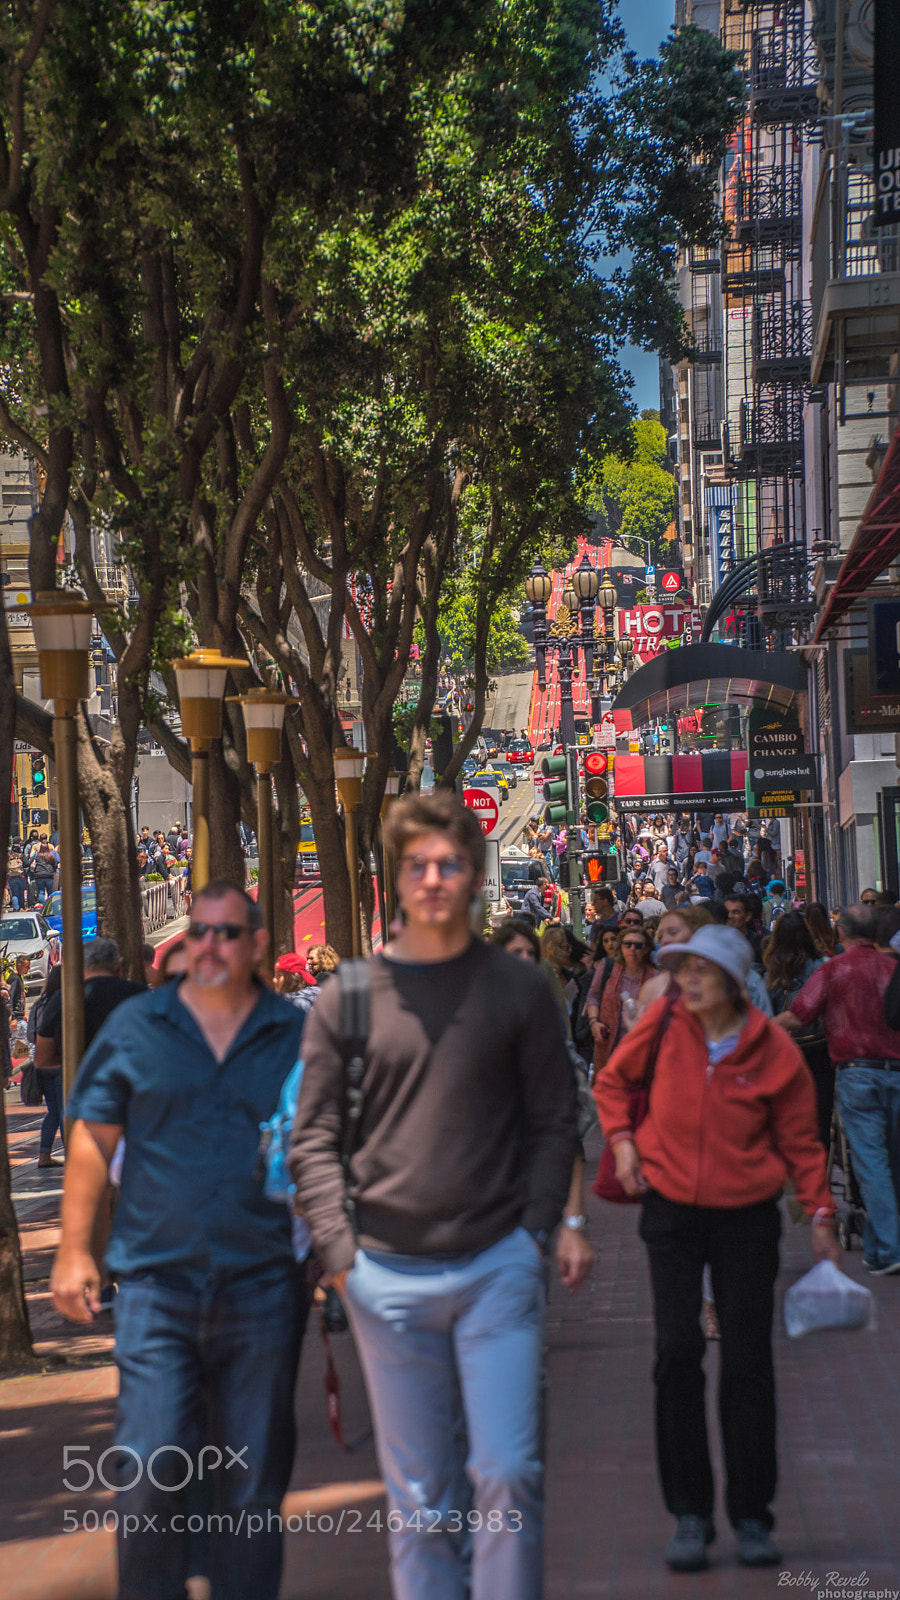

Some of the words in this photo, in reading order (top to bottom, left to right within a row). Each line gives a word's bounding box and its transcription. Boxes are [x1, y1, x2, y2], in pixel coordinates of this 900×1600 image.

[753, 733, 797, 743] CAMBIO
[765, 768, 796, 777] sunglass
[797, 767, 810, 775] hut
[472, 797, 492, 807] NOT
[642, 799, 670, 807] STEAKS
[761, 795, 795, 803] SOUVENIRS
[759, 807, 786, 818] ATM
